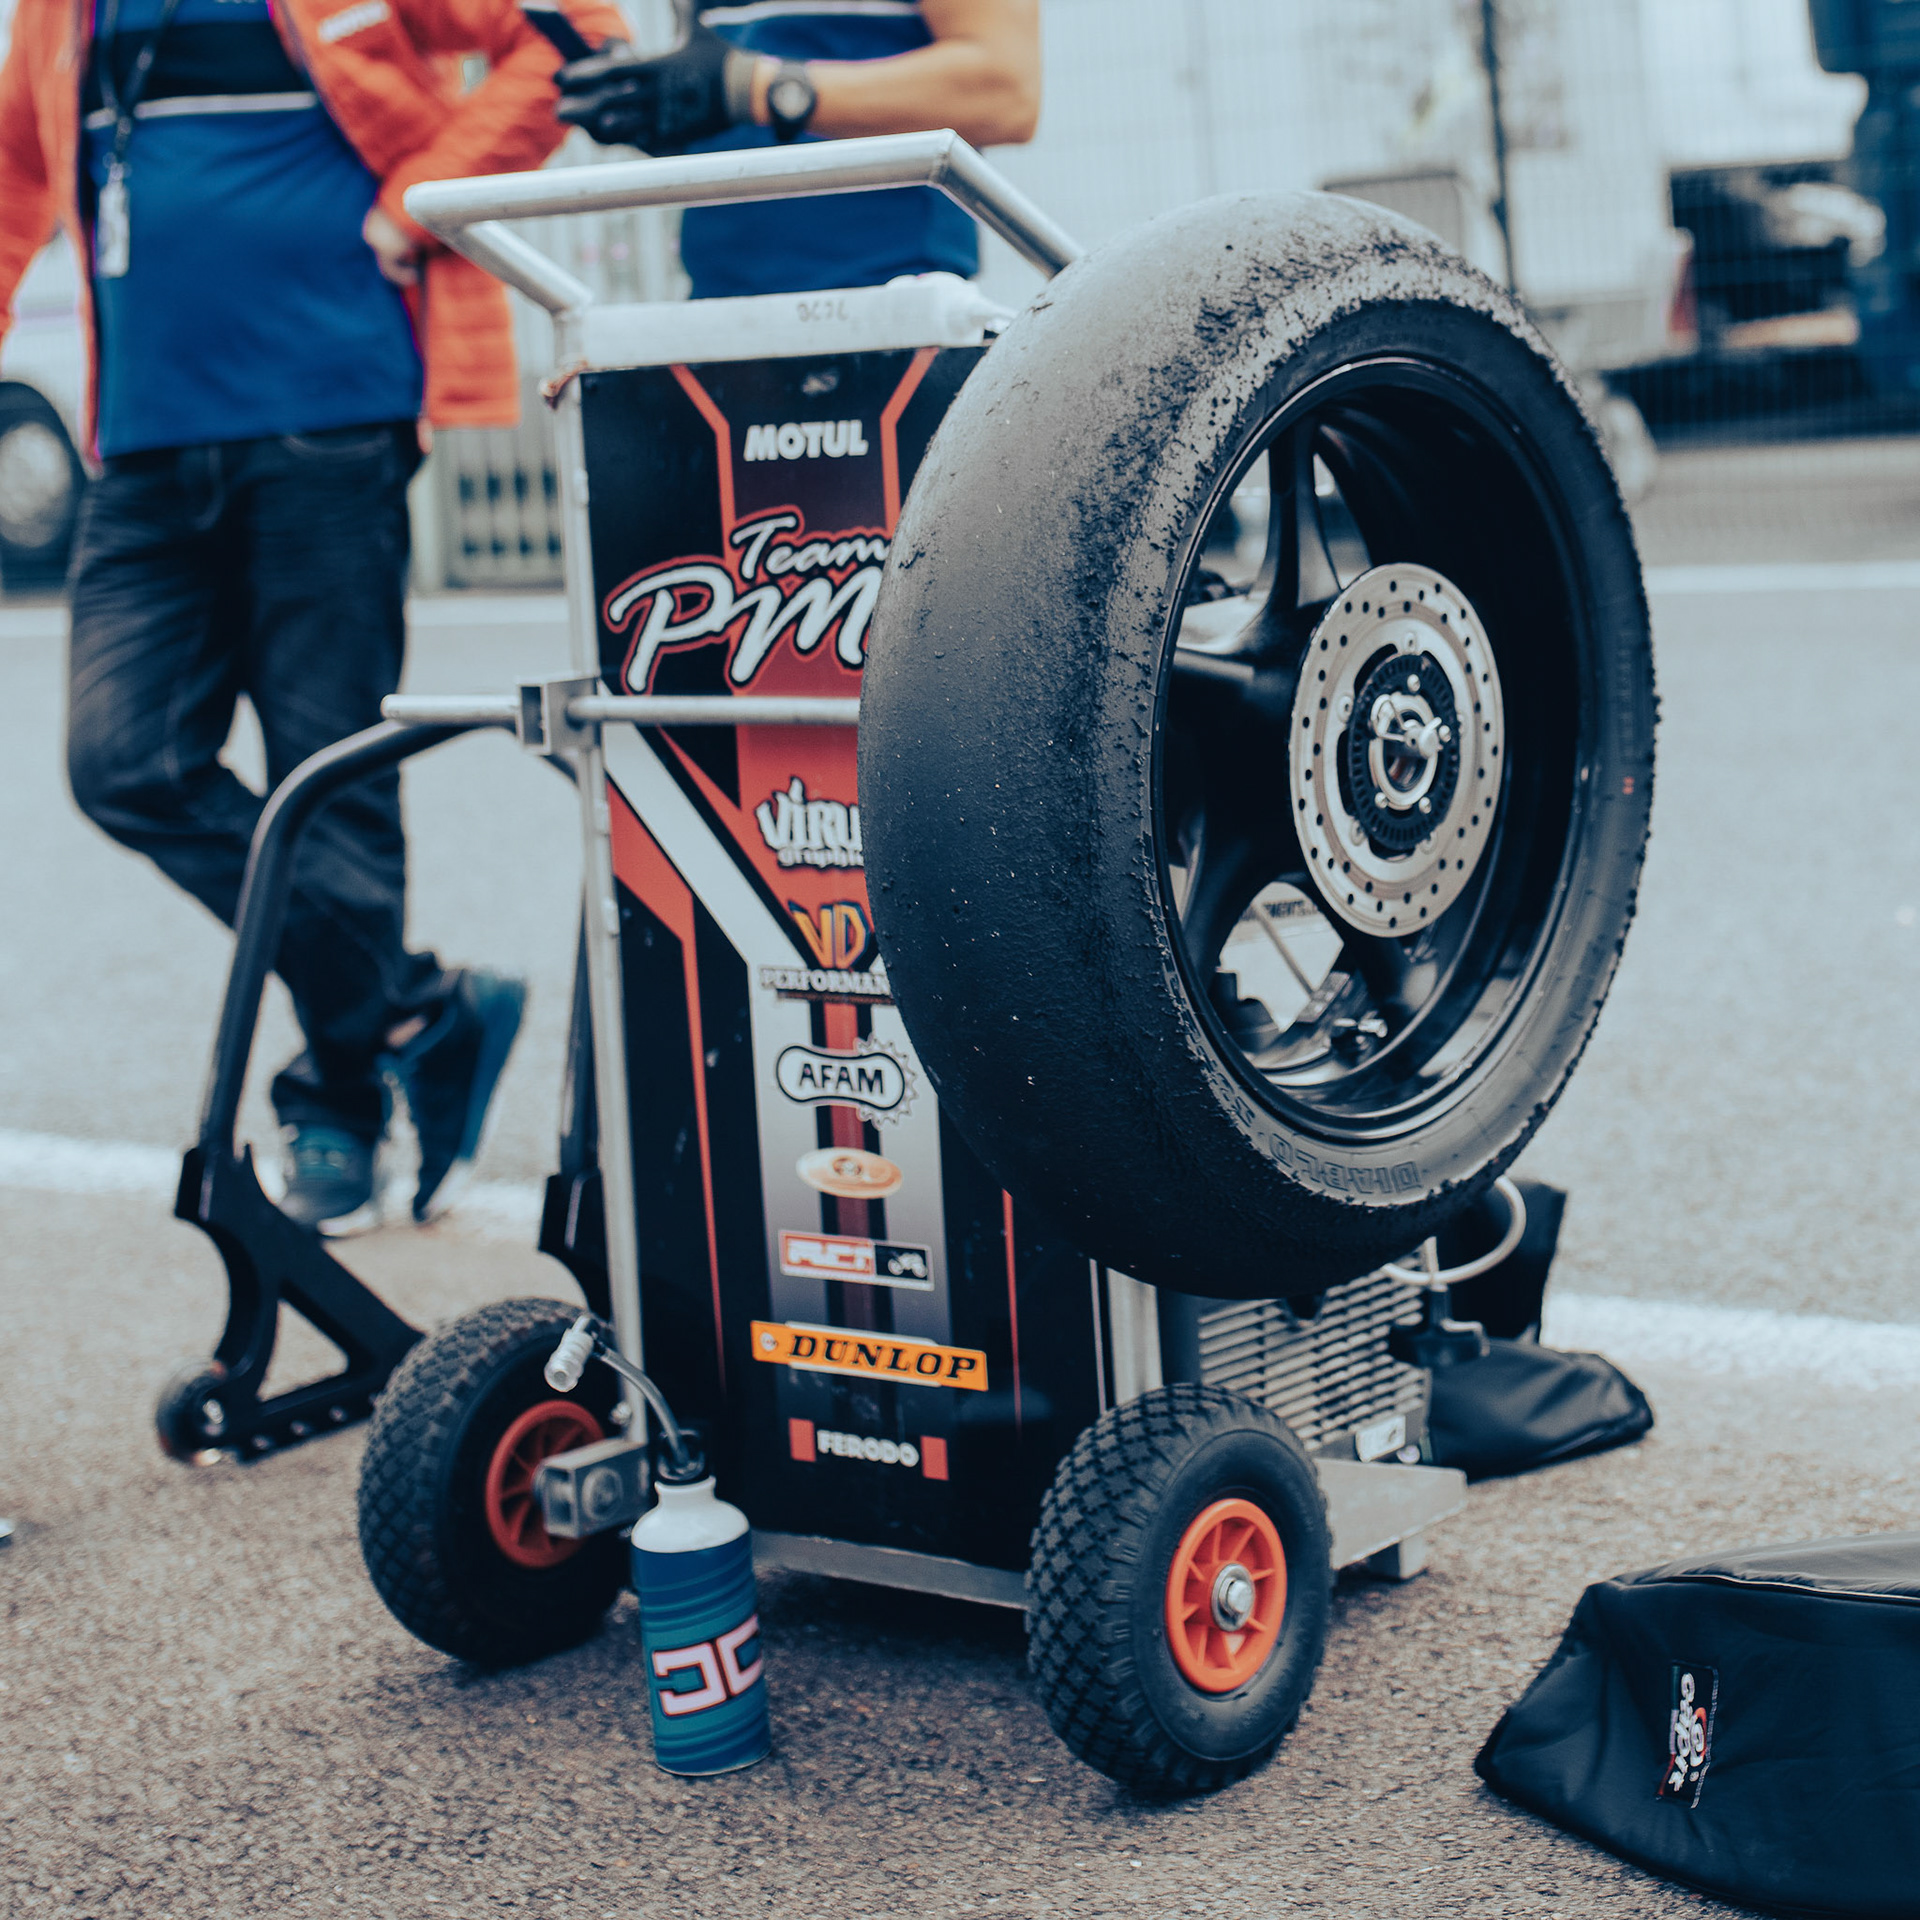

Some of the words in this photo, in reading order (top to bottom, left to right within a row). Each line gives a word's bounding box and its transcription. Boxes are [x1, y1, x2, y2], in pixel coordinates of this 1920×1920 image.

[744, 420, 868, 461] MOTUL
[731, 516, 891, 579] Team
[798, 1063, 884, 1094] AFAM
[1269, 1133, 1422, 1193] DIABLO
[789, 1335, 976, 1379] DUNLOP
[817, 1430, 919, 1467] FERODO
